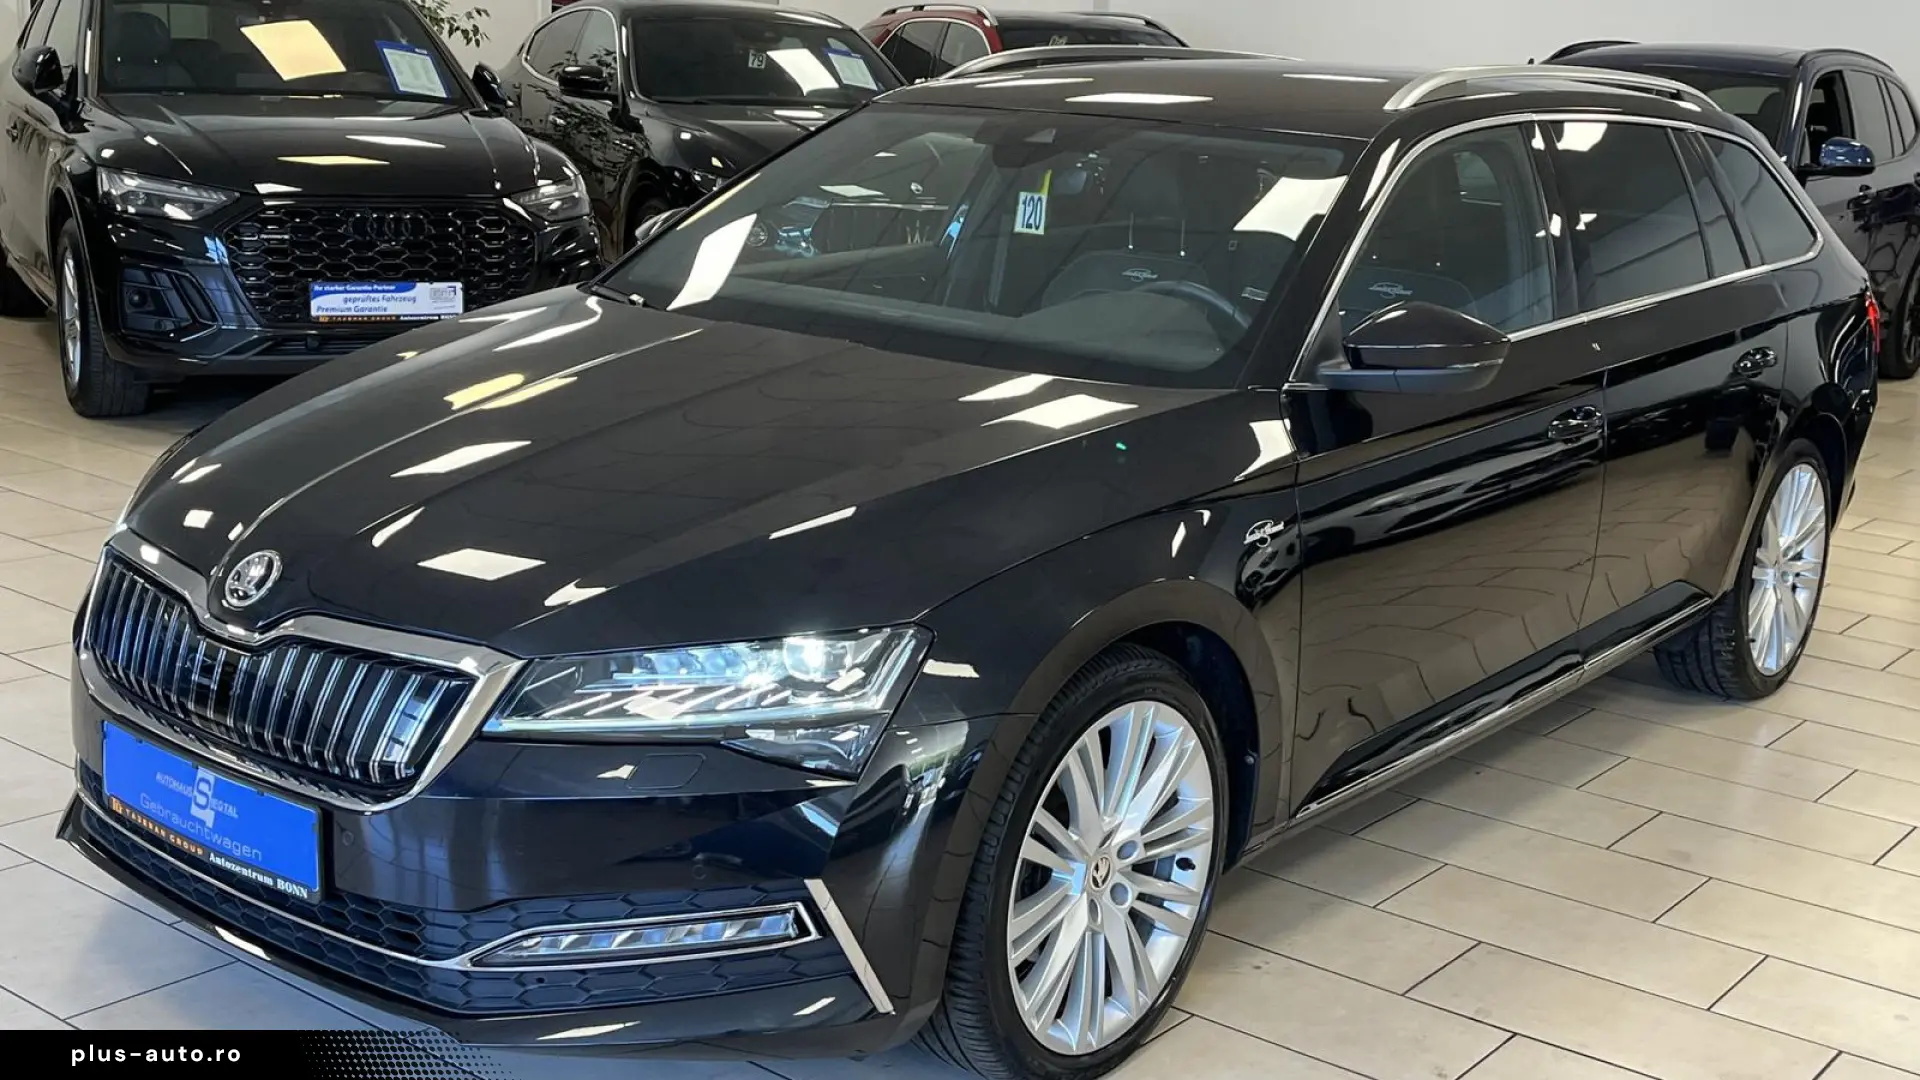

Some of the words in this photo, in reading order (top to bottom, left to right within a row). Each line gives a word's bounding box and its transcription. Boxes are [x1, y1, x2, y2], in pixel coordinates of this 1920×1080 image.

[751, 53, 764, 67] 79
[1021, 194, 1043, 231] 120
[316, 305, 352, 313] Premium
[354, 305, 388, 313] Garantie
[382, 294, 417, 304] Fahrzeug
[155, 771, 194, 798] AUTOHAUS
[139, 792, 263, 862] Gebrauchtwagen
[169, 834, 205, 855] GROUP
[209, 851, 274, 887] Autozentrum
[277, 879, 309, 899] BONN
